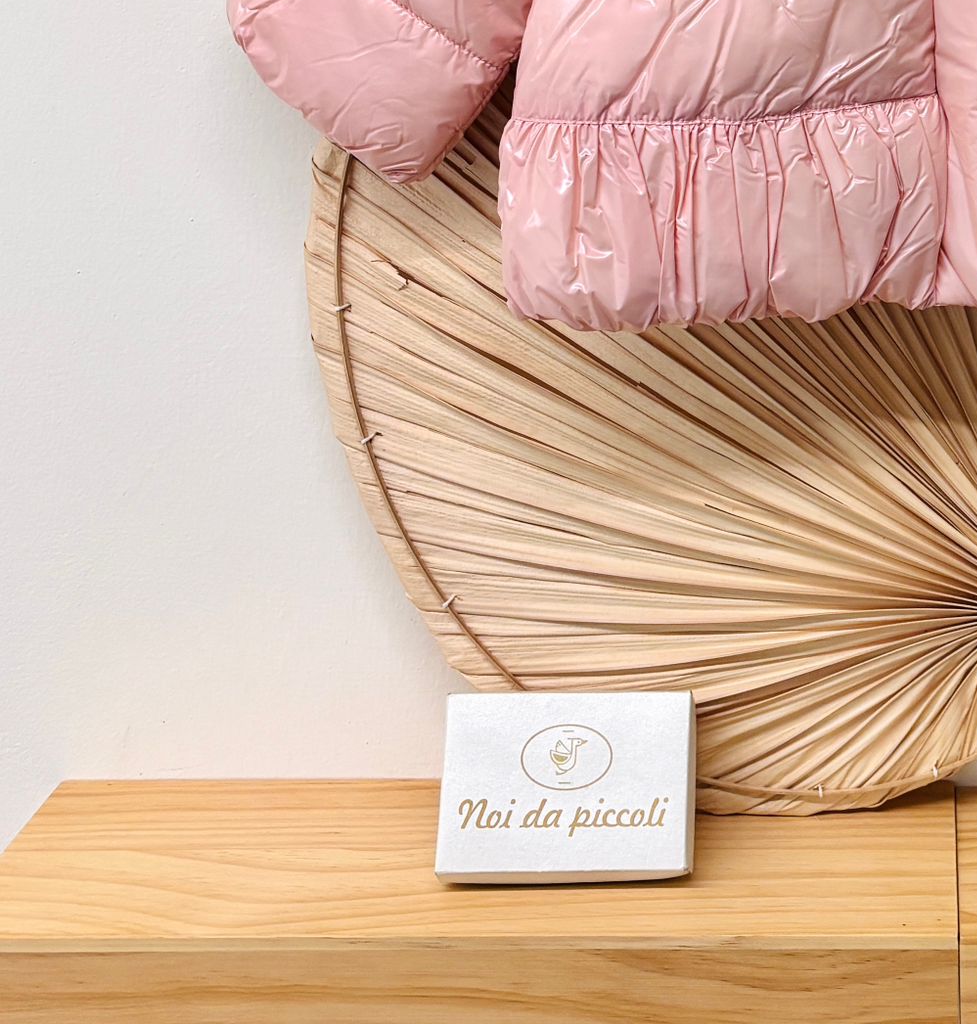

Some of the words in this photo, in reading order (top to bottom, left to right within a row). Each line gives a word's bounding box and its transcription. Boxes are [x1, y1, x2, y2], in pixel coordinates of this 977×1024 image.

[458, 798, 516, 829] Noi
[519, 798, 563, 828] da
[568, 797, 669, 837] piccoli
